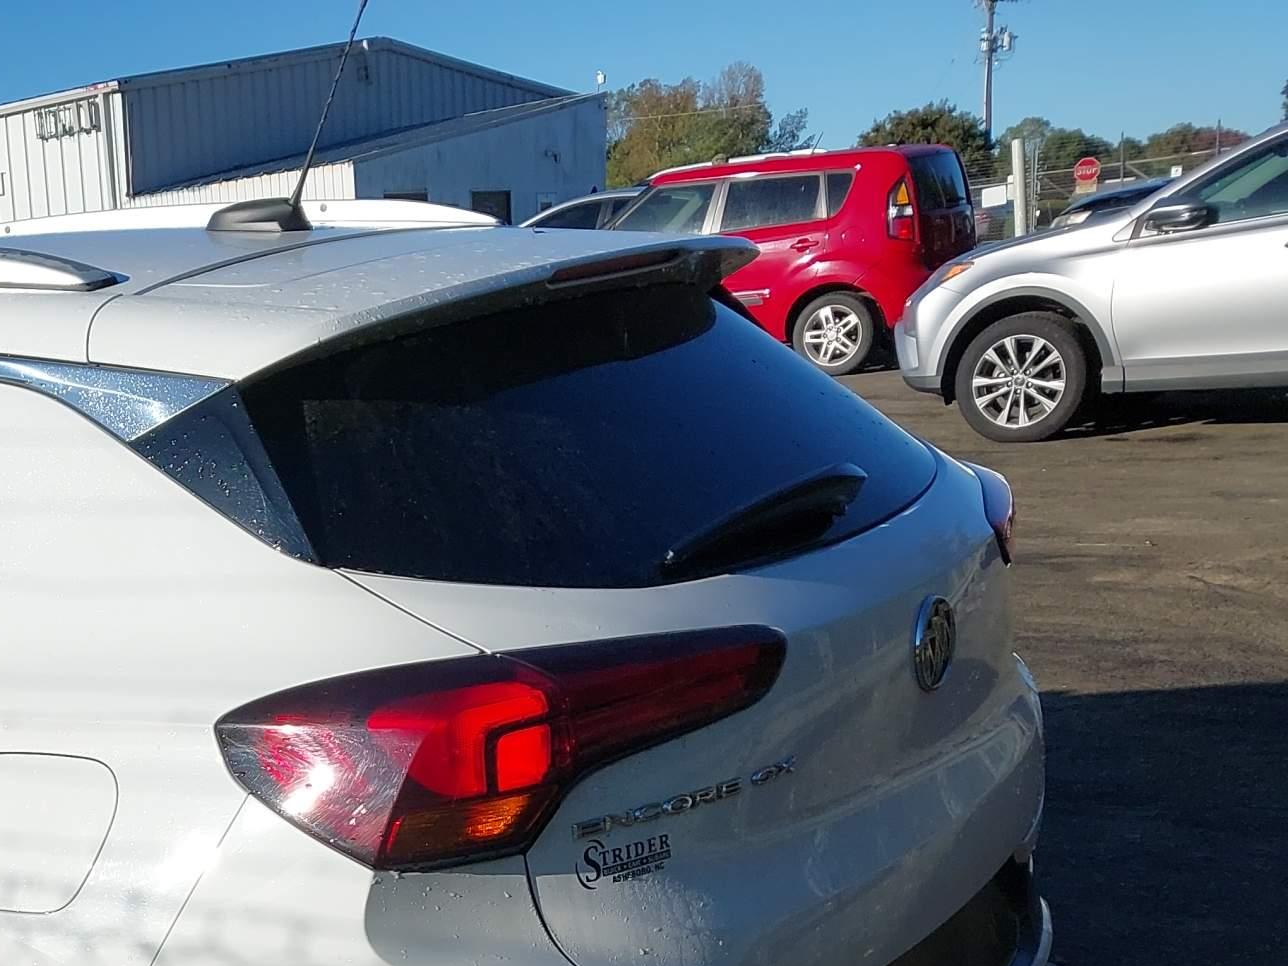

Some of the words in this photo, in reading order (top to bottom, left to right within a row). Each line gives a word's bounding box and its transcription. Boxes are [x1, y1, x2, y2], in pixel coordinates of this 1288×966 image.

[572, 777, 743, 840] ENCORE
[750, 755, 797, 786] GX
[583, 834, 671, 883] STRIDER
